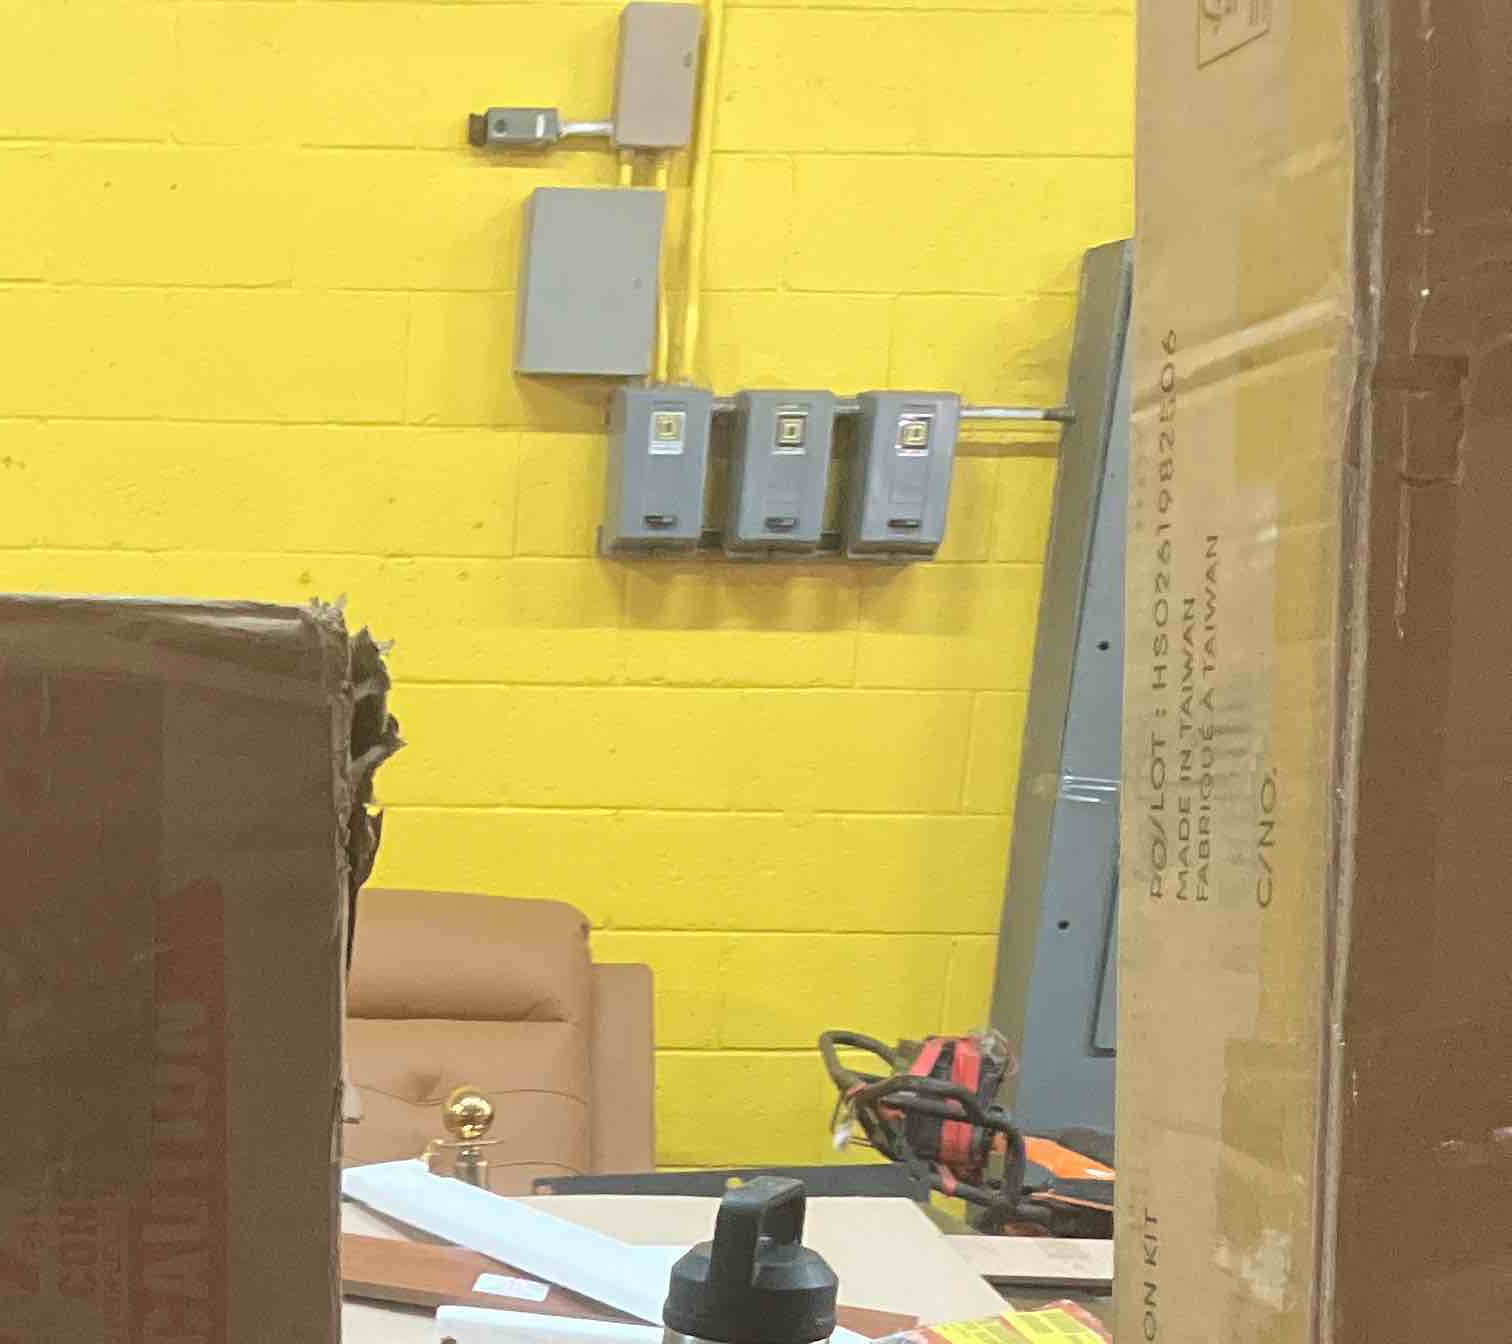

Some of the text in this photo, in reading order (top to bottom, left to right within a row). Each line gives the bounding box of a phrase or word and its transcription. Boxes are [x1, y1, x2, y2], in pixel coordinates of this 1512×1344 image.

[1201, 534, 1219, 678] TAIWAN
[1175, 597, 1196, 901] MADE IN TAIWAN
[1144, 1209, 1159, 1268] KIT
